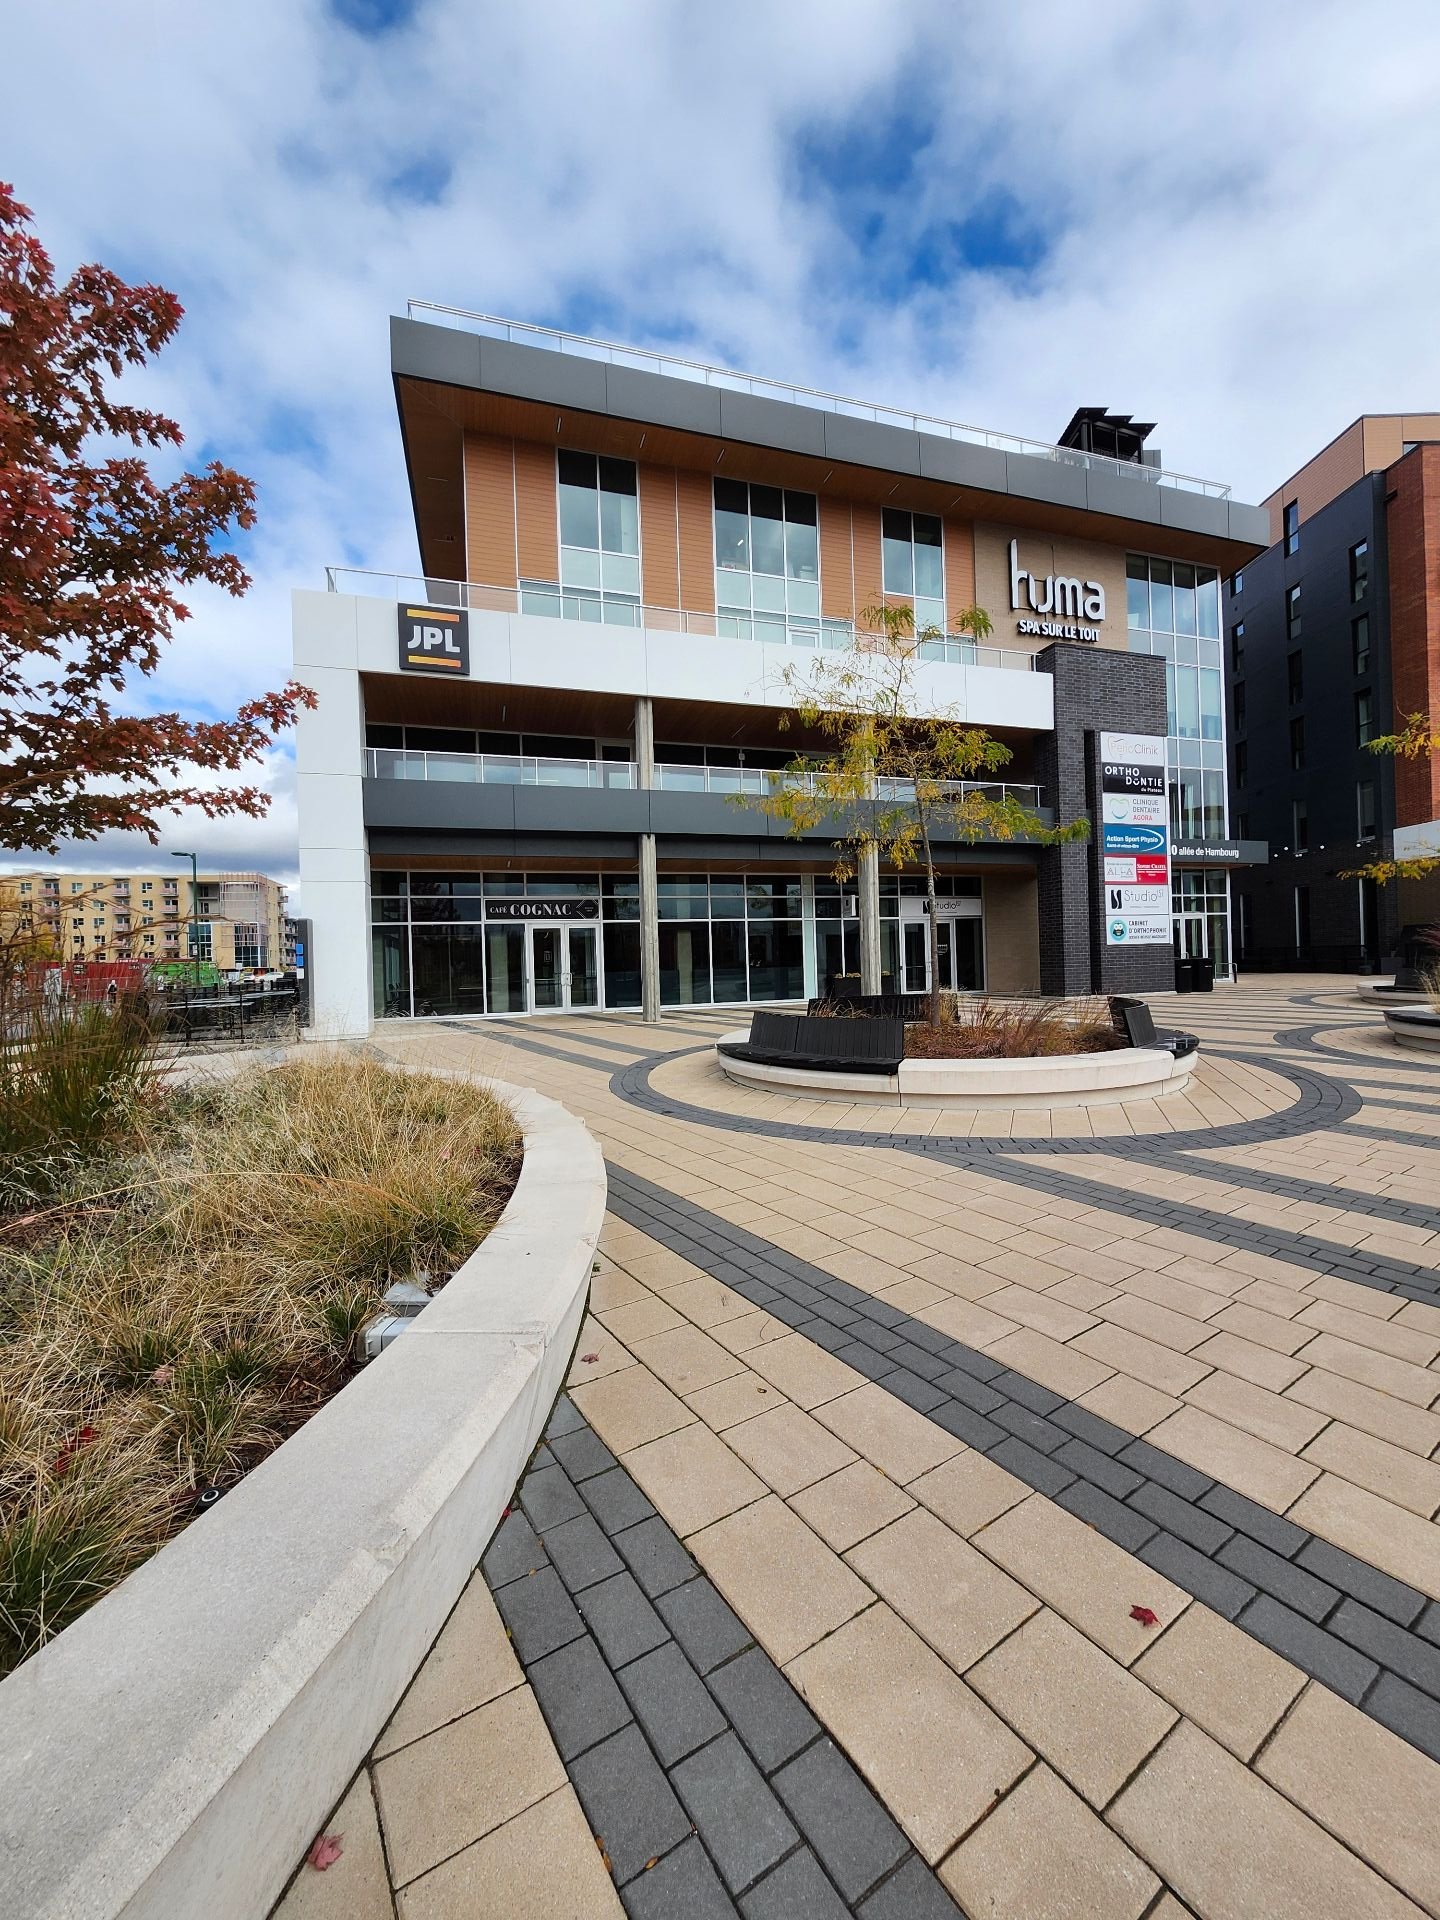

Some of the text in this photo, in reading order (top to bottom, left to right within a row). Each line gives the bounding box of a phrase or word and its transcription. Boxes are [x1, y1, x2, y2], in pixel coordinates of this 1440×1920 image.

[1011, 539, 1106, 620] huma
[1019, 619, 1100, 641] SPA SUR LE TOIT
[407, 625, 461, 653] JPL
[1105, 766, 1139, 776] ORTHO
[1125, 776, 1163, 787] DONTIE
[1132, 798, 1159, 806] CLINIQUE
[1132, 806, 1161, 814] DENTAIRE
[1124, 835, 1140, 843] Sport
[1140, 836, 1159, 844] Physio
[1178, 846, 1195, 856] allée
[1195, 847, 1205, 856] de
[1205, 848, 1239, 858] Hambourg
[510, 904, 571, 915] COGNAC
